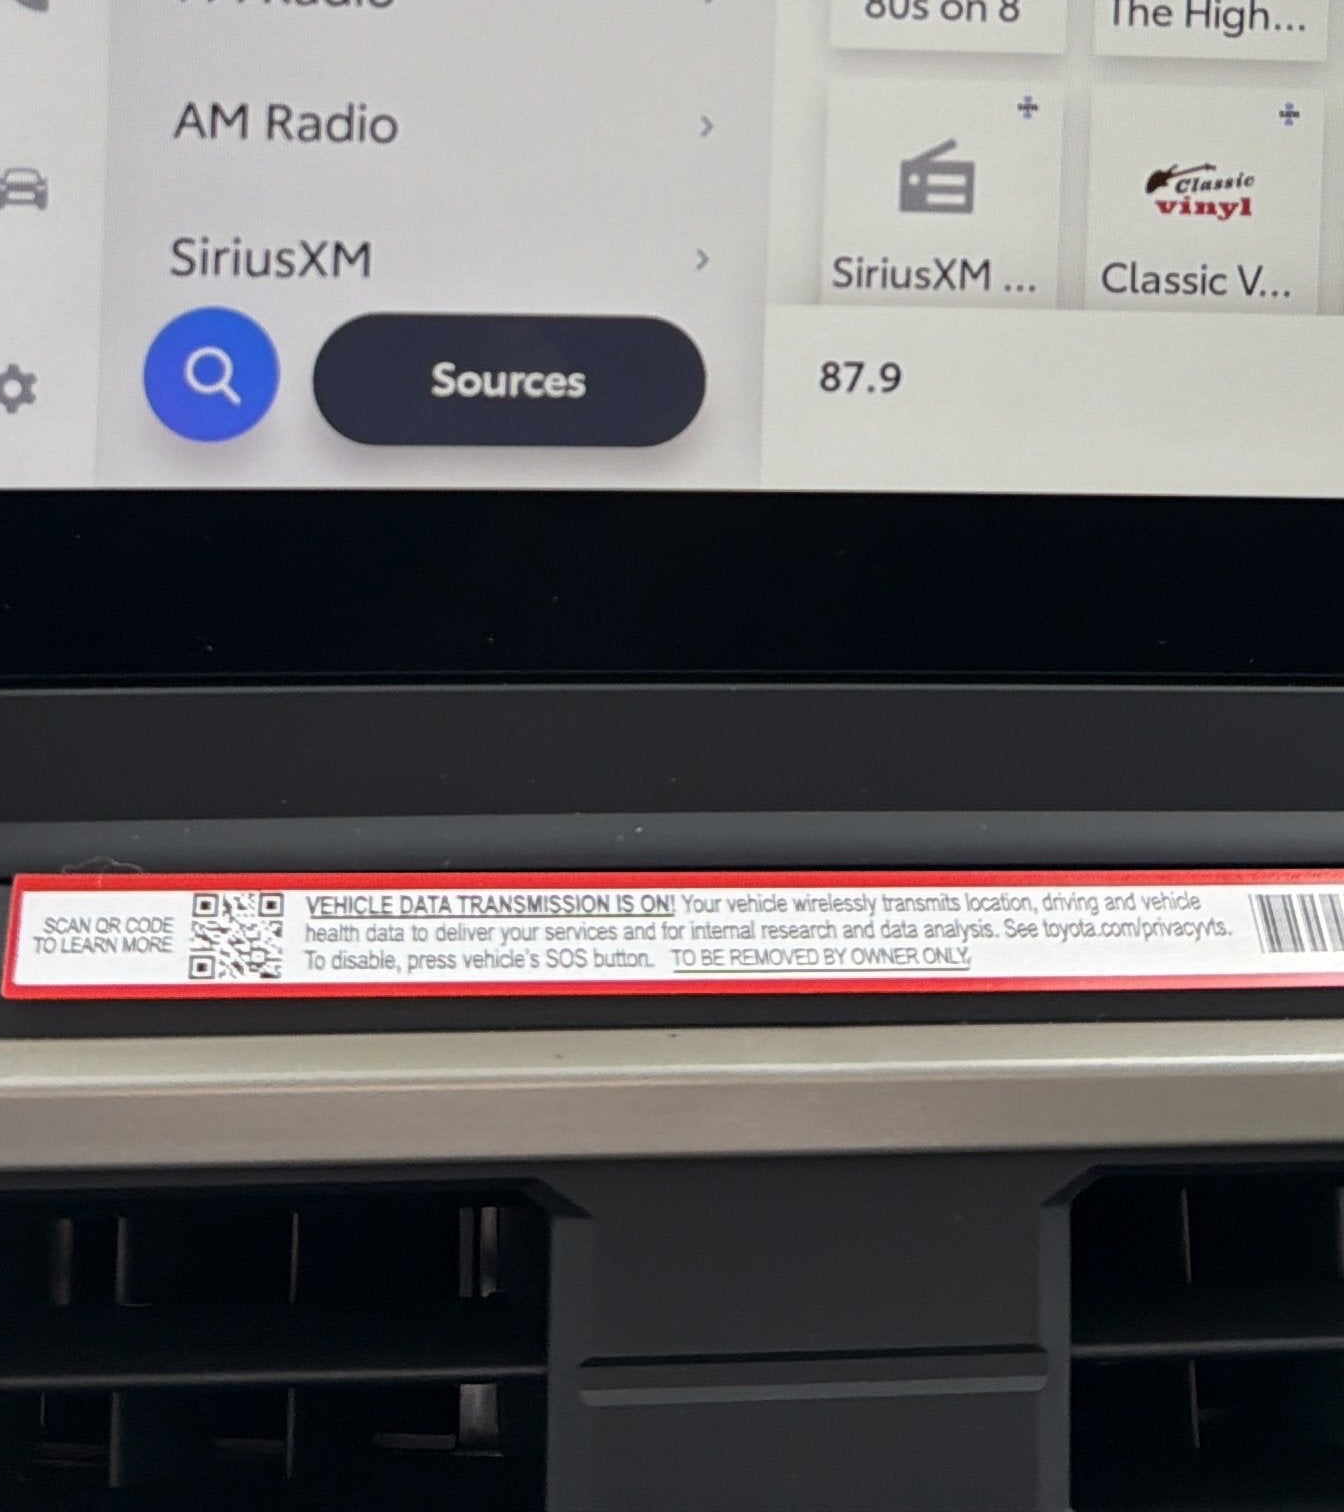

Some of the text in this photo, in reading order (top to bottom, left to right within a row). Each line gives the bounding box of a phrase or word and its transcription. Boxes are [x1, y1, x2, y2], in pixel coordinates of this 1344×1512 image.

[173, 101, 400, 145] AM Radio
[1174, 172, 1256, 194] Classic
[1155, 195, 1253, 221] vinyl
[171, 236, 372, 279] SiriusXM
[831, 256, 992, 294] SiriusXM
[1100, 262, 1293, 300] Classic V...
[430, 361, 587, 401] Sources
[819, 361, 903, 396] 87.9
[306, 891, 1201, 916] VEHICLE DATA TRANSMISSION IS ON! Your vehicle wirelessly transmits location, driving and vehicle
[43, 917, 175, 934] SCAN QR CODE
[304, 922, 359, 943] health
[365, 922, 405, 942] data
[412, 924, 429, 942] to
[435, 922, 495, 942] deliver
[500, 926, 539, 947] your
[544, 923, 617, 942] services
[623, 921, 656, 941] and
[661, 921, 686, 941] for
[690, 920, 756, 940] internal
[760, 920, 838, 939] research
[843, 920, 876, 939] and
[880, 919, 919, 939] data
[923, 918, 1000, 943] analysis.
[1004, 918, 1039, 938] See
[34, 936, 174, 953] TO LEARN MORE
[305, 949, 327, 970] To
[331, 949, 402, 973] disable,
[407, 954, 457, 975] press
[463, 948, 540, 970] vehicle's
[546, 948, 589, 969] SOS
[594, 948, 656, 968] button.
[669, 948, 696, 966] TO
[700, 948, 726, 966] BE
[729, 947, 820, 966] REMOVED
[823, 947, 846, 965] BY
[850, 946, 919, 965] OWNER
